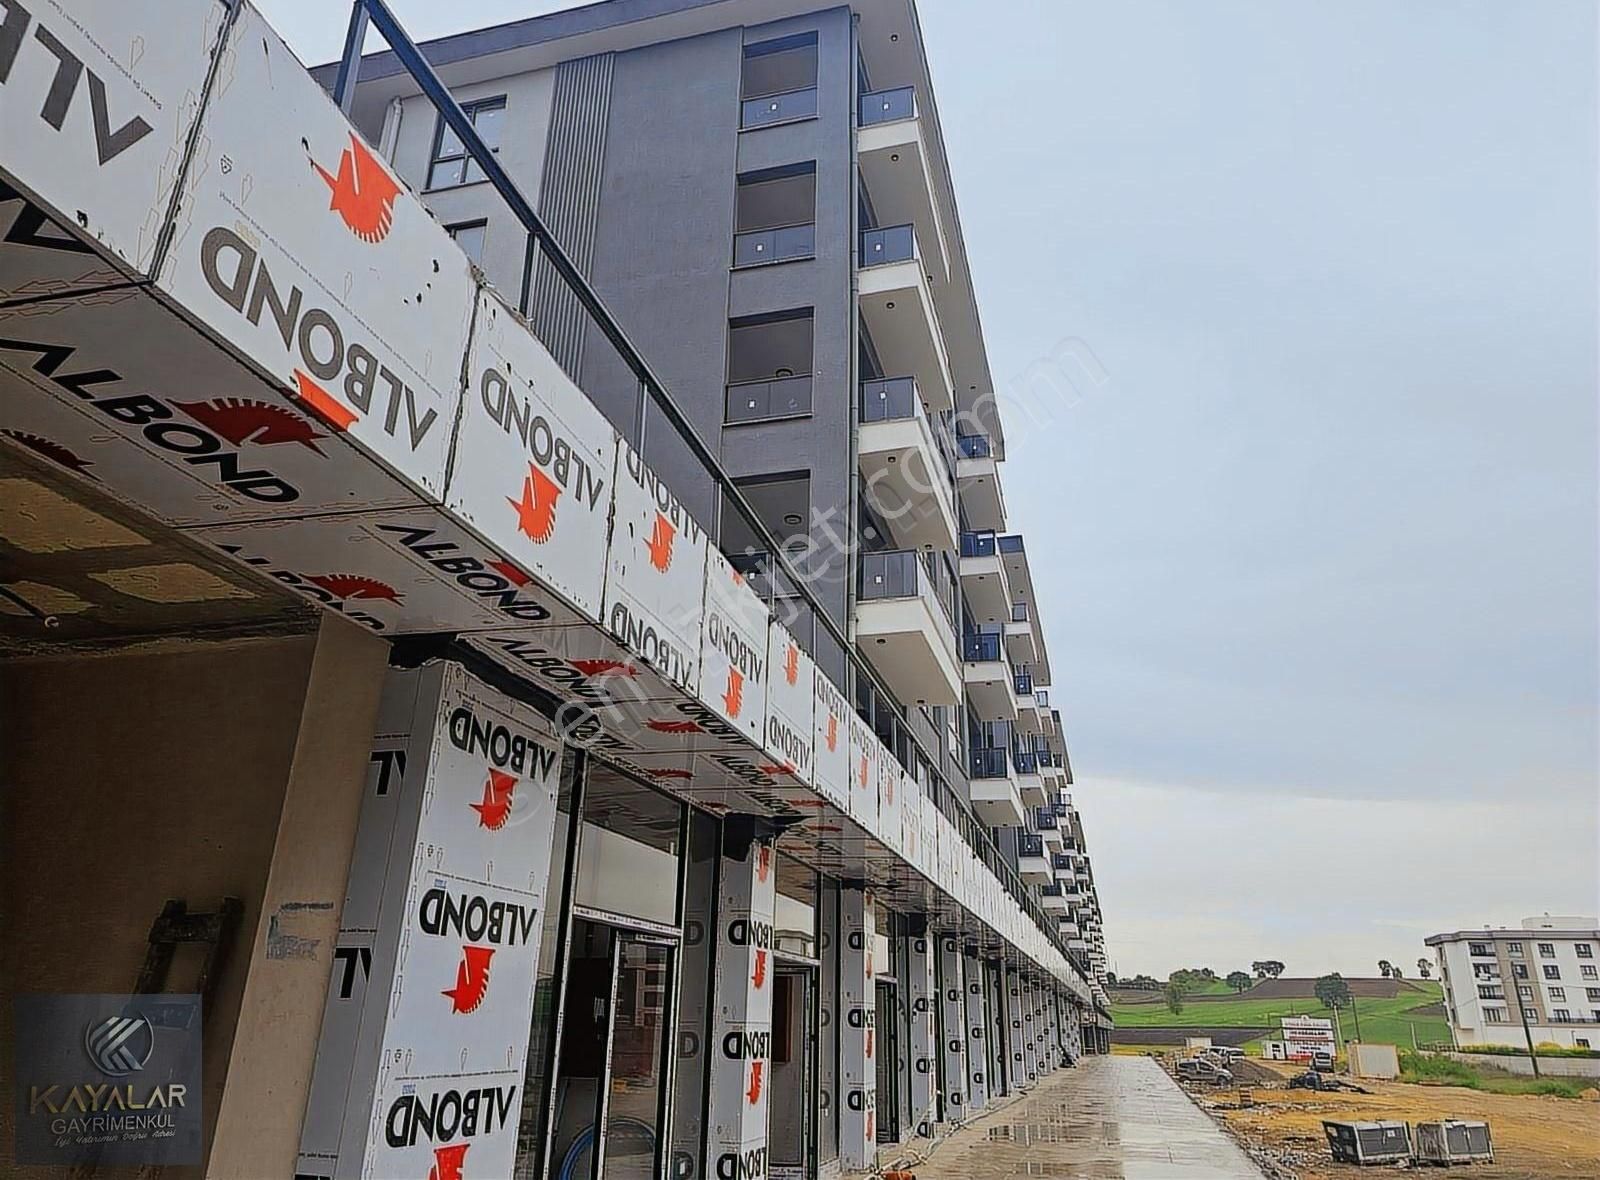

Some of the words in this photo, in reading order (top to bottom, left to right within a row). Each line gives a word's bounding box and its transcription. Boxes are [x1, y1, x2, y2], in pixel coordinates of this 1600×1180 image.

[201, 226, 438, 452] ALBOND
[0, 338, 300, 503] ALBOND
[480, 368, 604, 512] ALBOND
[375, 523, 551, 621] ALBOND
[611, 601, 693, 688] ALBOND
[708, 612, 763, 684] ALBOND
[449, 707, 556, 783] ALBOND
[769, 715, 811, 769] ALBOND
[419, 888, 537, 946] ALBOND
[385, 1085, 516, 1148] ALBOND
